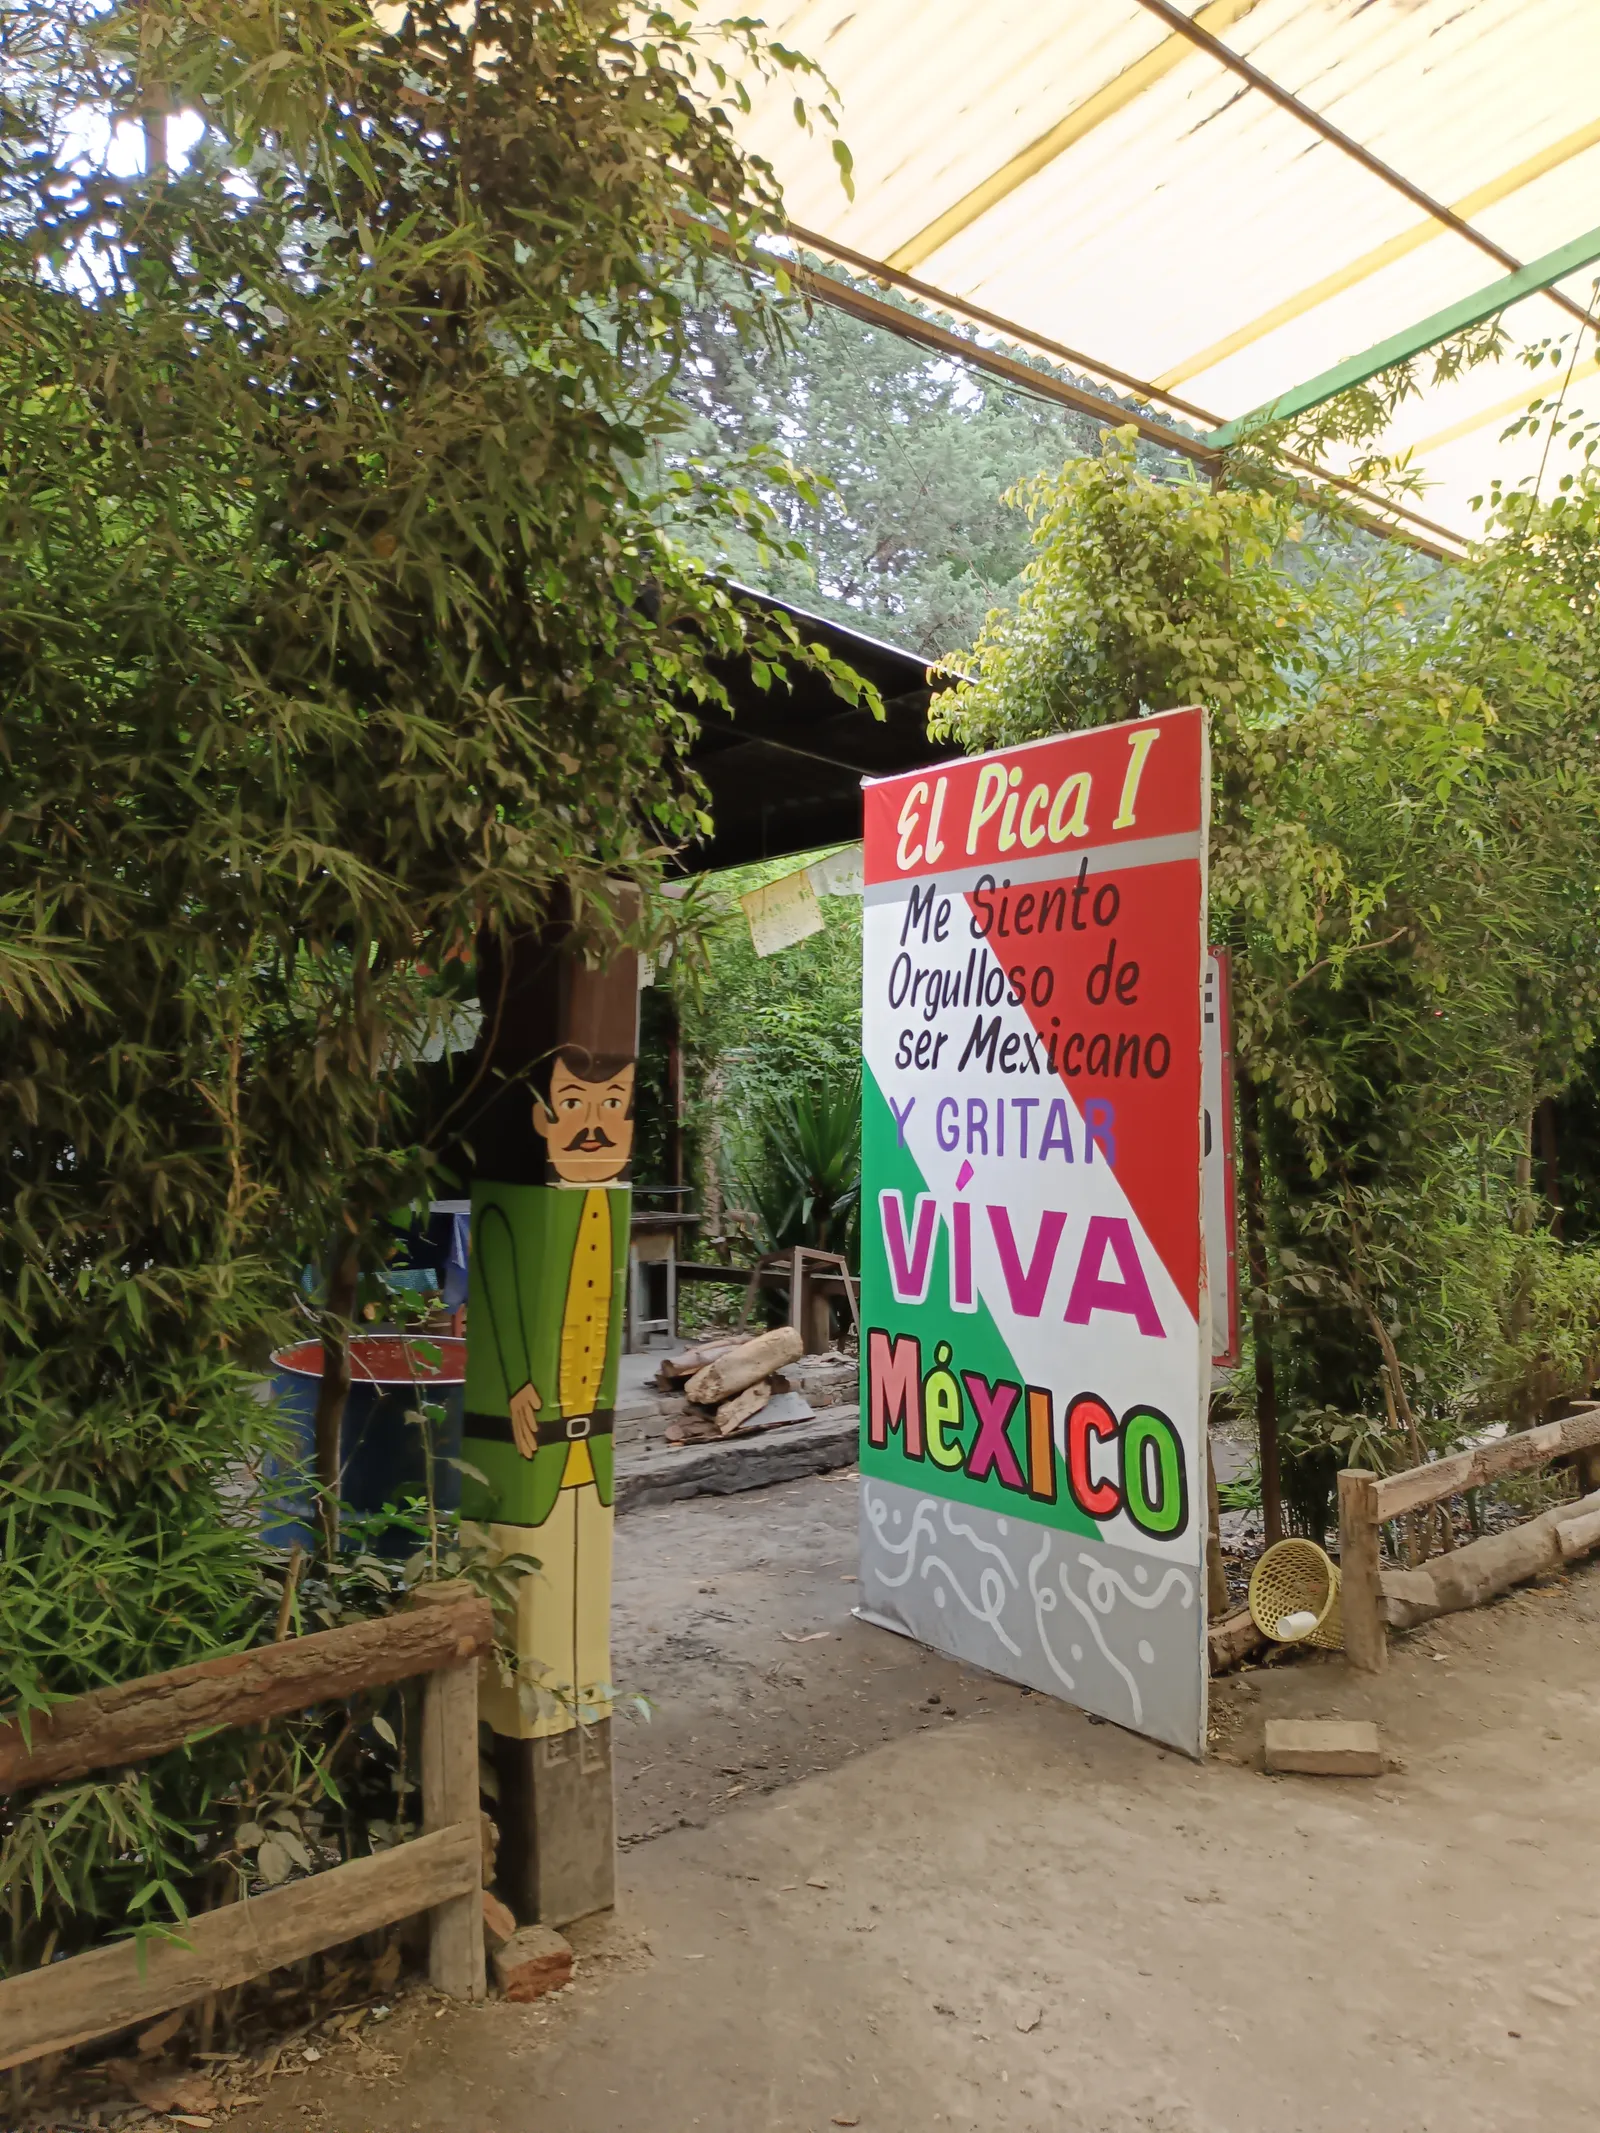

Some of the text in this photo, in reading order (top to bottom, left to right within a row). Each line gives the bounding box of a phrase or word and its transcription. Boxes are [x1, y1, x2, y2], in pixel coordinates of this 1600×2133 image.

[896, 728, 1160, 871] El Pica I
[899, 856, 1120, 946] Me Siento
[888, 948, 1054, 1021] Orgulloso
[1086, 938, 1140, 1006] de
[894, 1014, 1171, 1080] ser Mexicano
[889, 1097, 1116, 1166] Y GRITAR
